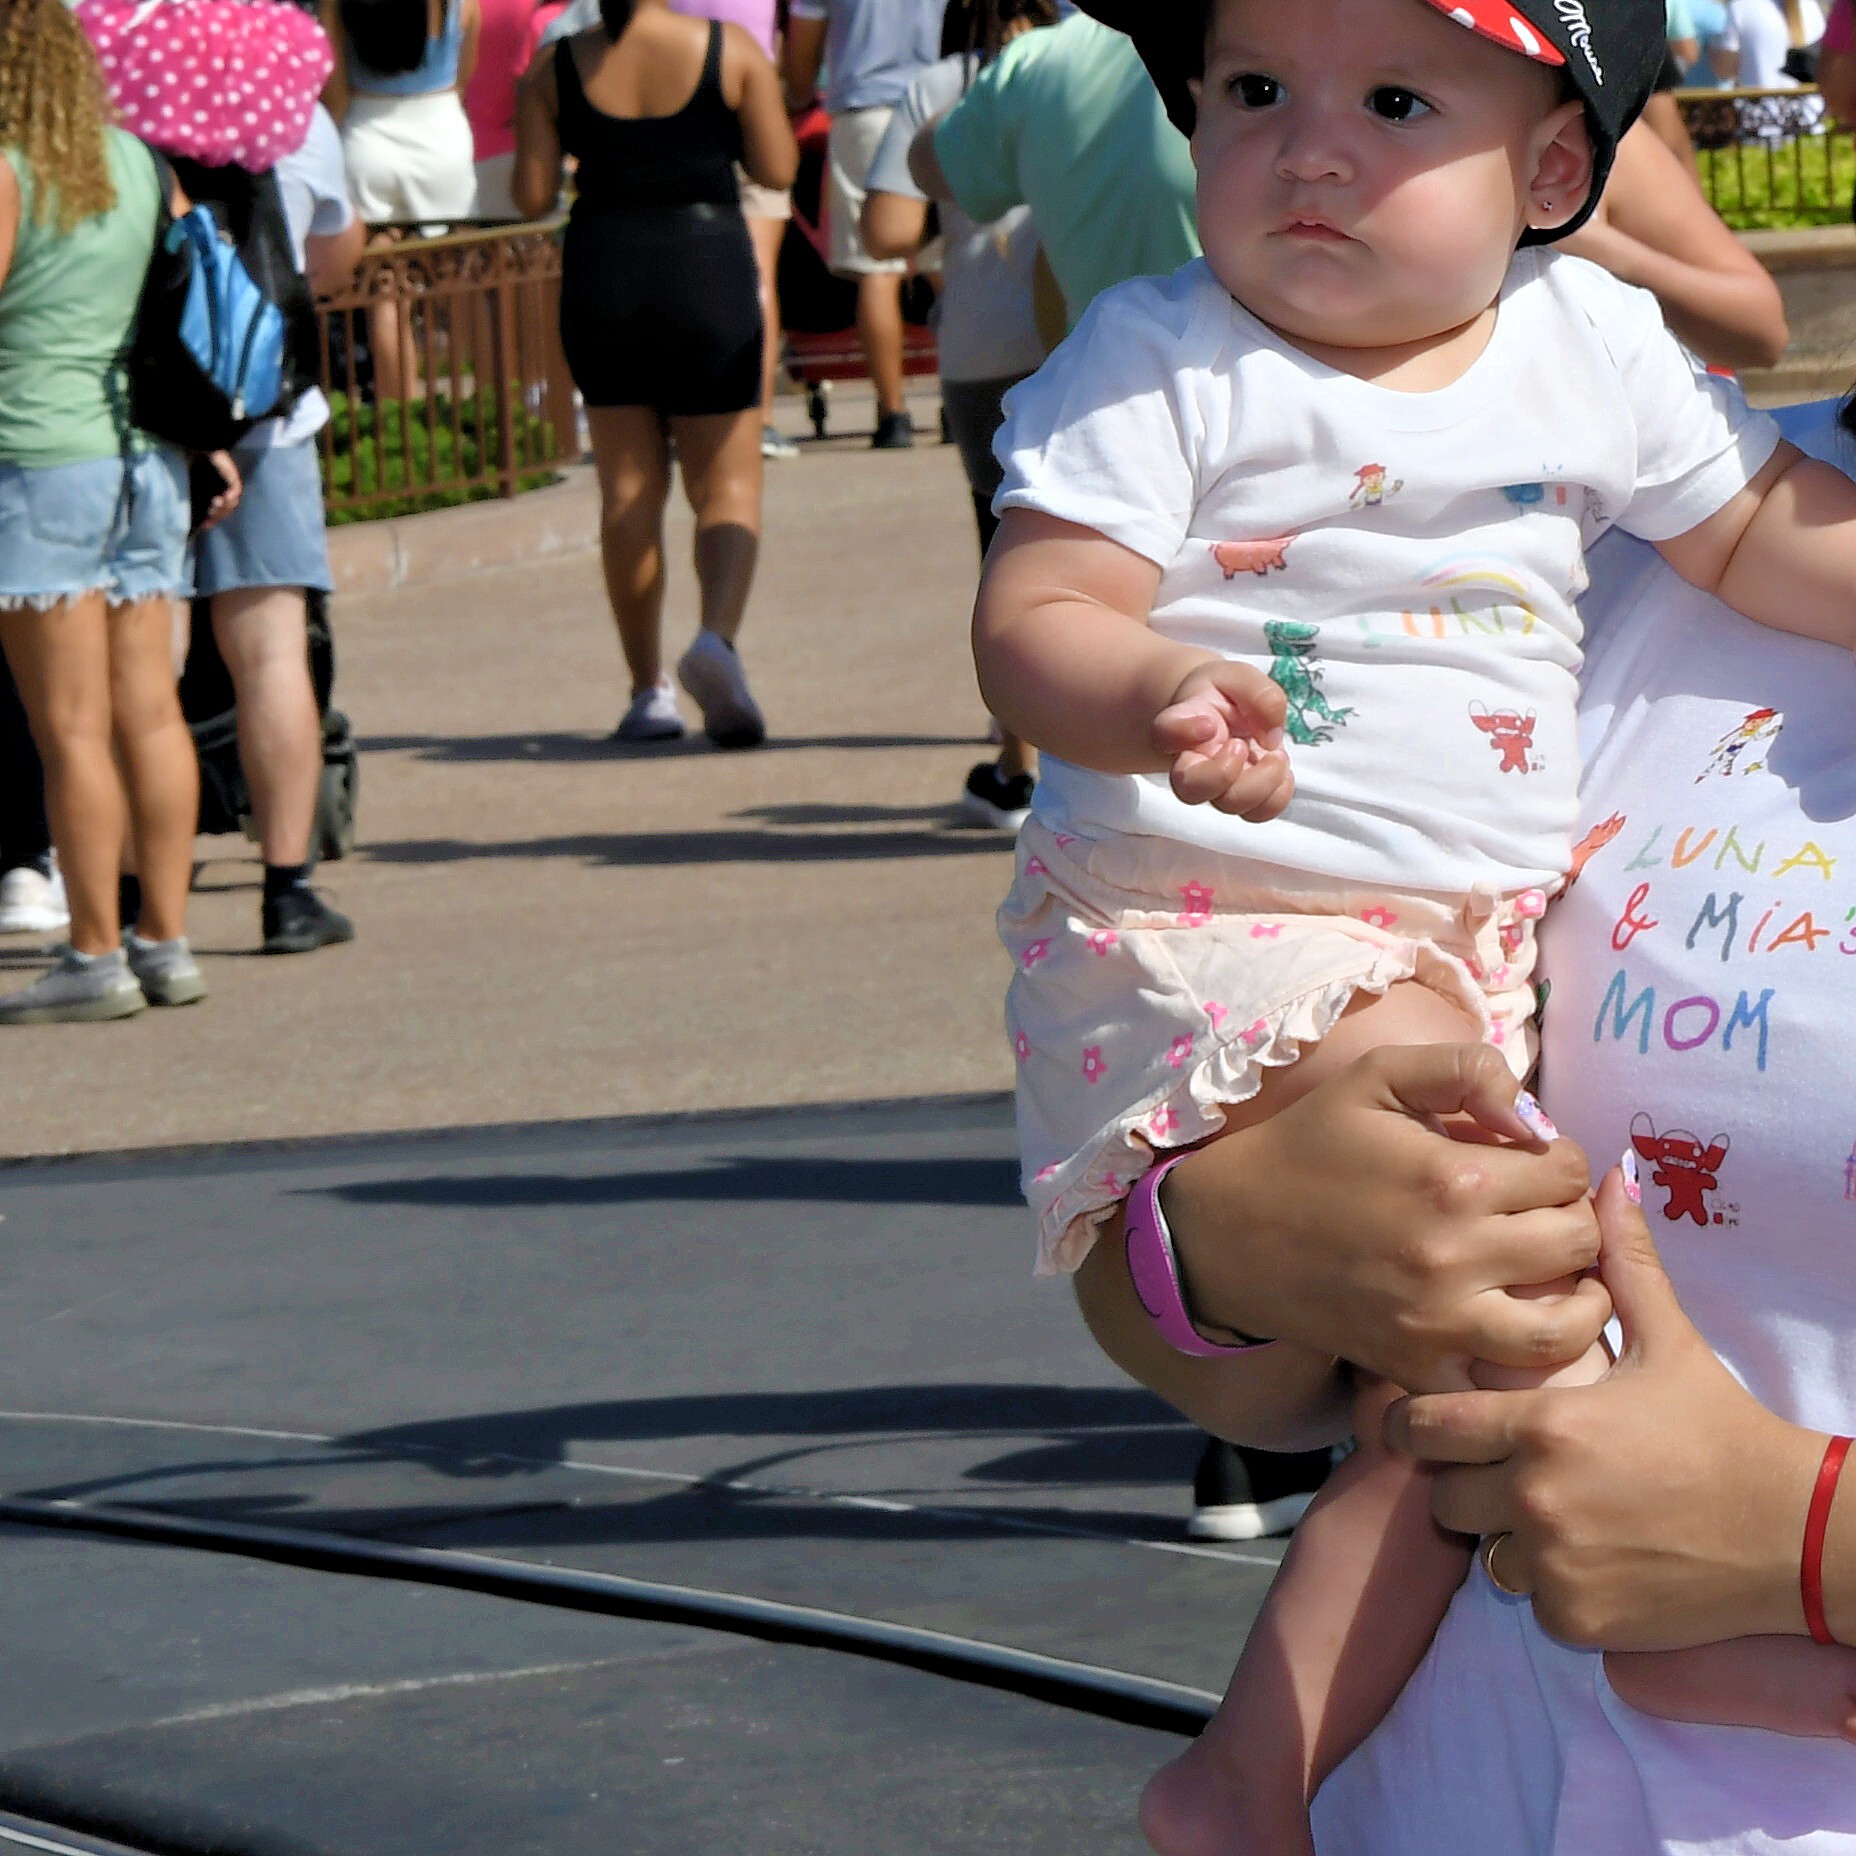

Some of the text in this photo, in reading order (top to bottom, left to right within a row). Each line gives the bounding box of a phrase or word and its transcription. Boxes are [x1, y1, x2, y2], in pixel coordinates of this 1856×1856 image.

[1624, 824, 1838, 881] LUNA
[1611, 882, 1659, 952] &
[1594, 969, 1776, 1072] MOM
